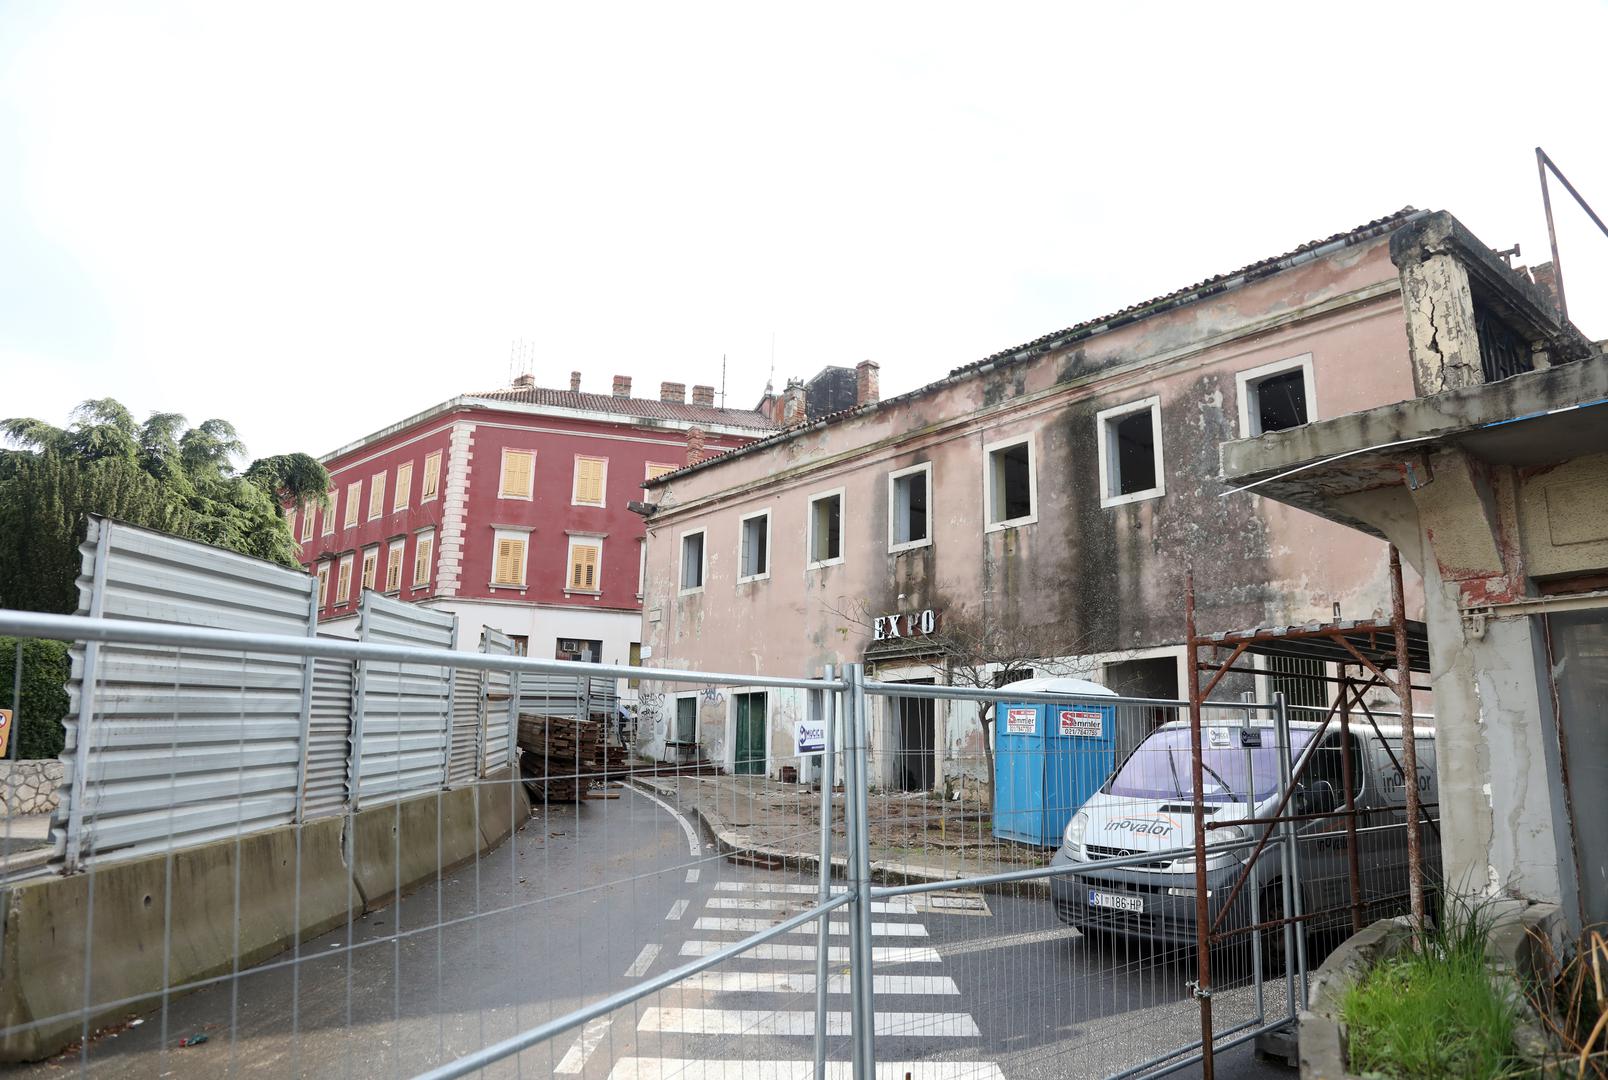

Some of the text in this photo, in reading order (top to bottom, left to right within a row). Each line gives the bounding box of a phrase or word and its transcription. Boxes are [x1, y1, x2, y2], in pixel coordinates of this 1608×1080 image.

[873, 610, 935, 640] EXPO
[1104, 819, 1173, 836] inovator
[1111, 896, 1142, 911] 186-HP
